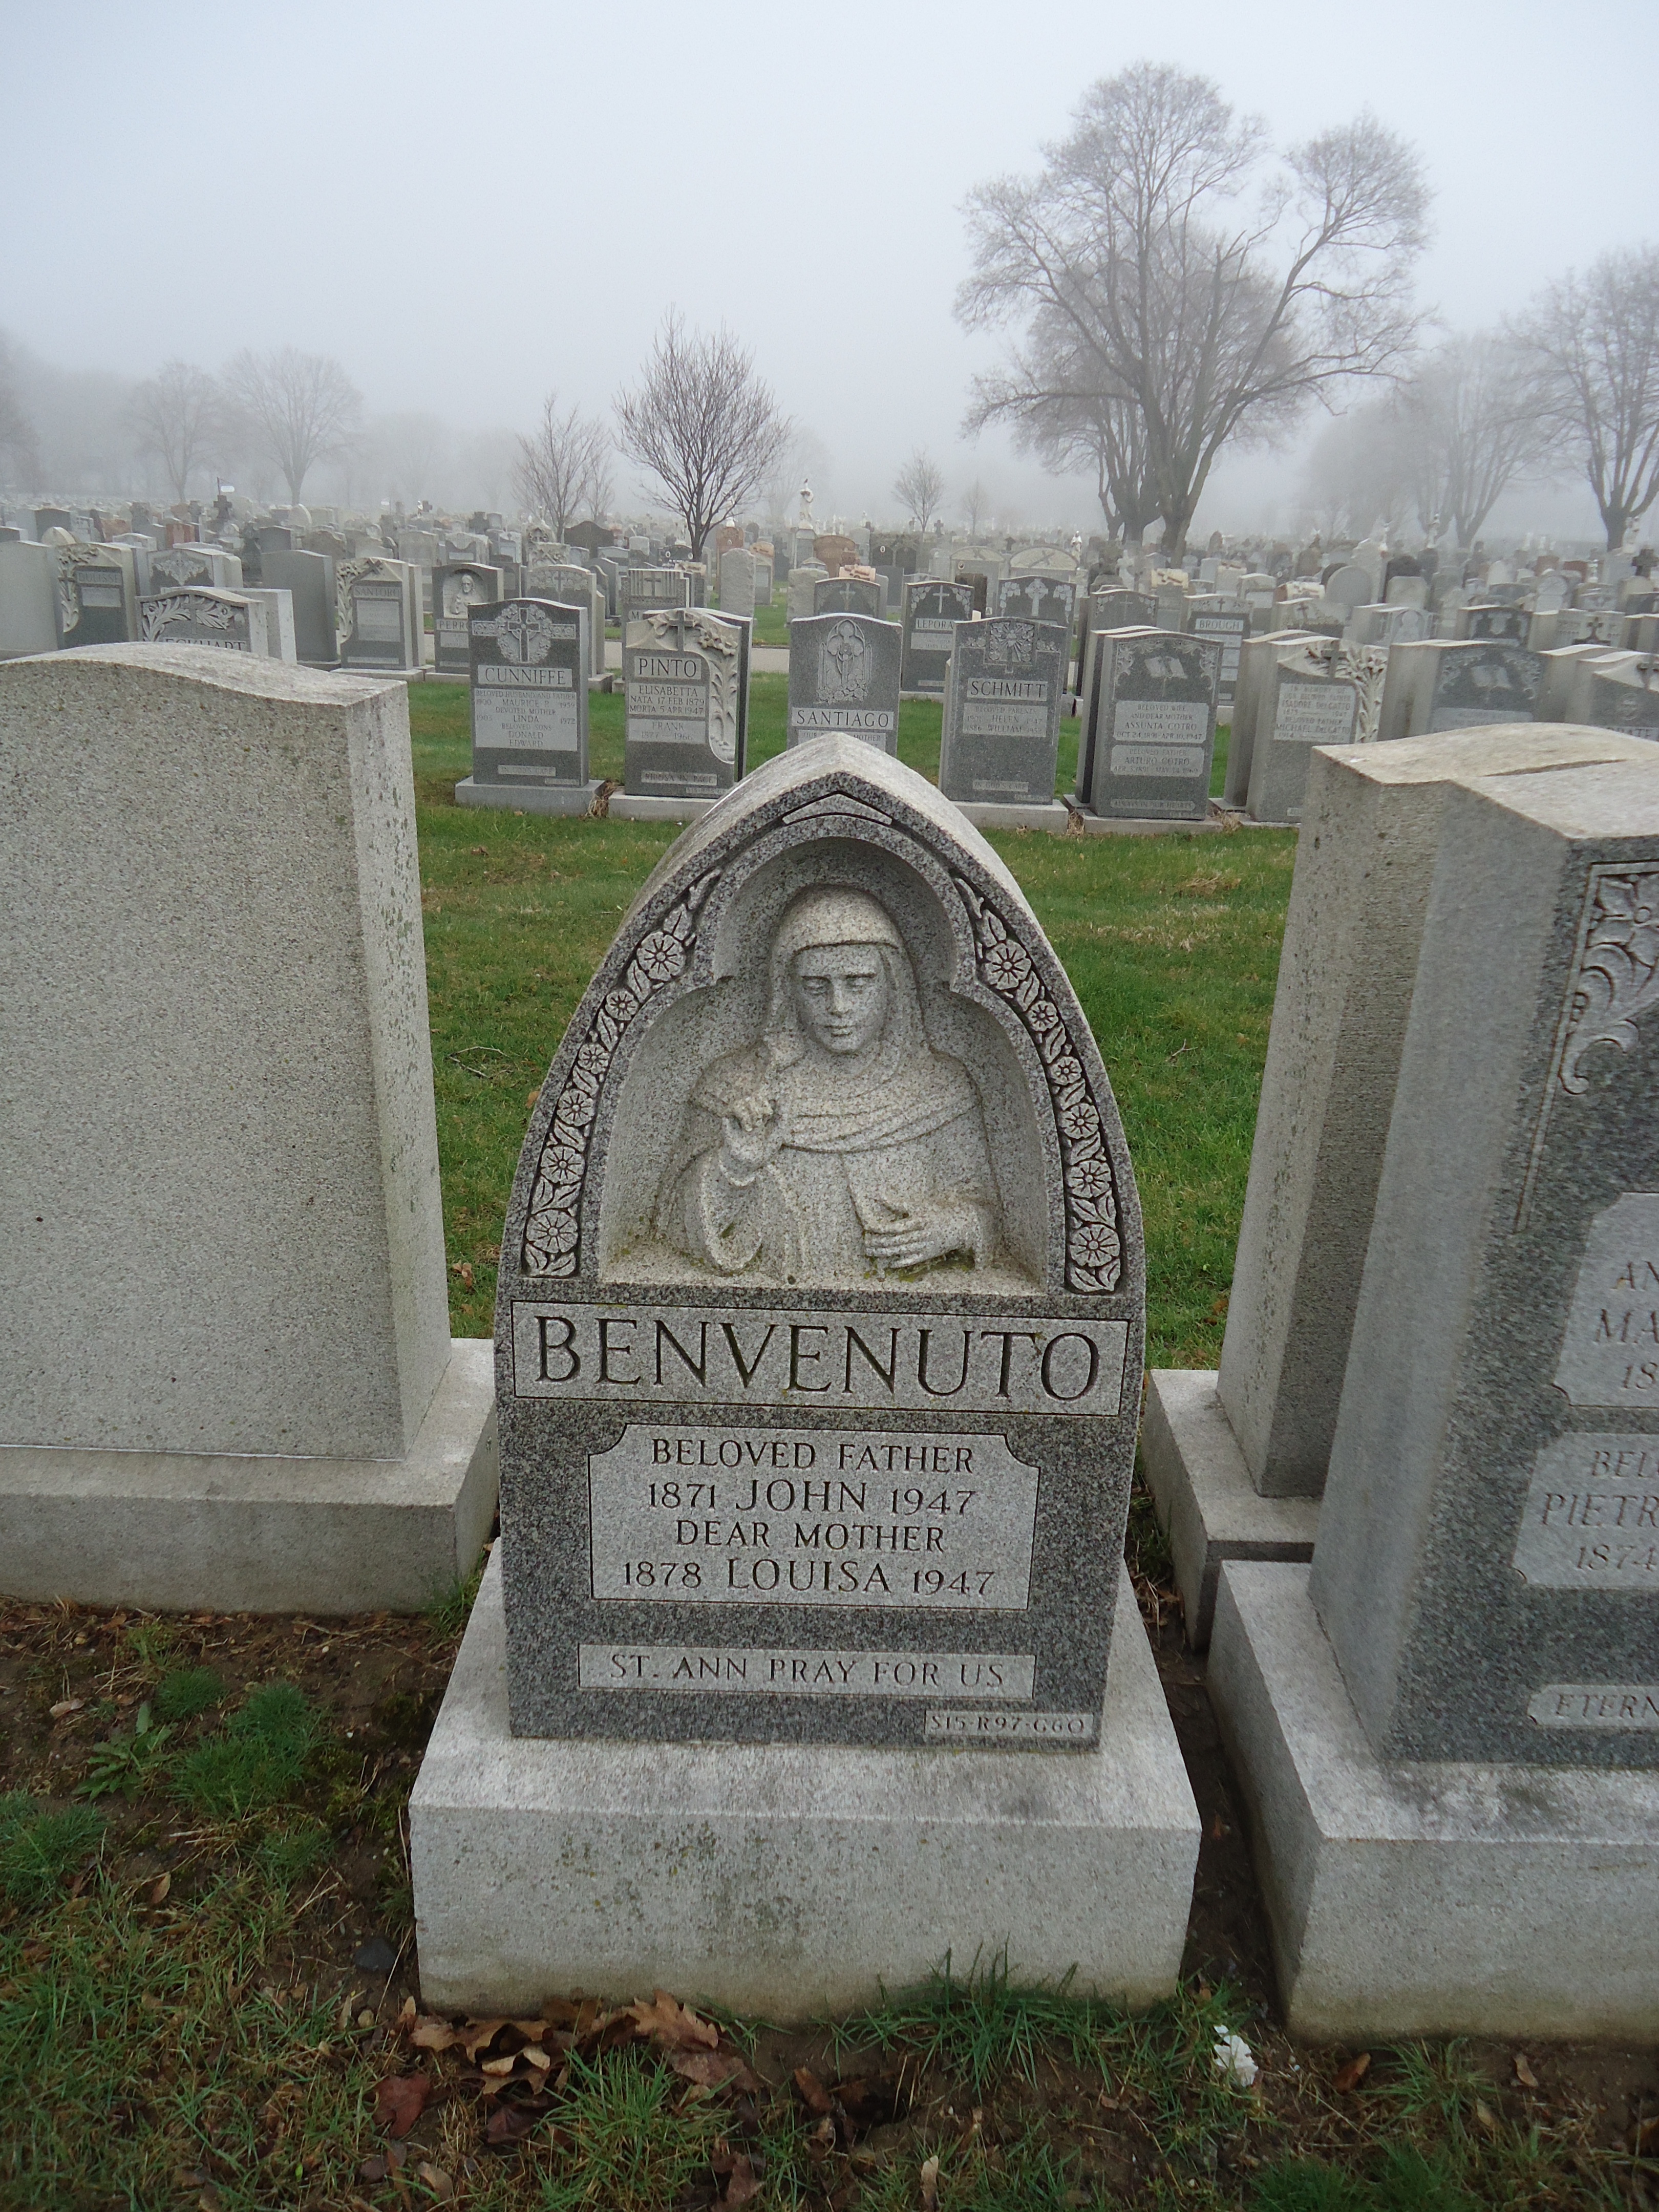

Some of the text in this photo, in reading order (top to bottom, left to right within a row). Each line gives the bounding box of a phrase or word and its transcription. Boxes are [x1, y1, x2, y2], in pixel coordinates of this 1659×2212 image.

[355, 587, 399, 597] SANTORO
[439, 620, 468, 630] PERR
[1199, 620, 1240, 630] BROUGH
[639, 657, 697, 678] PINTO
[485, 668, 566, 685] CUNNIFFE
[639, 685, 698, 697] ELISABETTA
[970, 680, 1046, 698] SCHMITT
[502, 699, 539, 708] MAURICE
[631, 695, 652, 704] NATA
[657, 696, 665, 705] 17
[686, 698, 705, 707] 1879
[629, 705, 656, 713] MORTA
[513, 715, 540, 724] LINDA
[796, 710, 889, 728] SANTIAGO
[992, 714, 1019, 723] HELEN
[652, 721, 684, 731] FRANK
[988, 724, 1022, 733] WILLIAM
[508, 731, 544, 739] DONALD
[509, 739, 544, 748] EDWARD
[1161, 758, 1190, 766] COTRO
[1593, 1308, 1659, 1345] MA
[535, 1315, 1100, 1403] BENVENUTO
[651, 1438, 974, 1474] BELOVED FATHER
[1591, 1450, 1659, 1479] BEL
[648, 1479, 976, 1516] 1871 JOHN 1947
[1542, 1492, 1659, 1529] PIETR
[676, 1520, 946, 1554] DEAR MOTHER
[624, 1558, 995, 1596] 1878 LOUISA 1947
[610, 1654, 1005, 1688] ST. ANN PRAY FOR US
